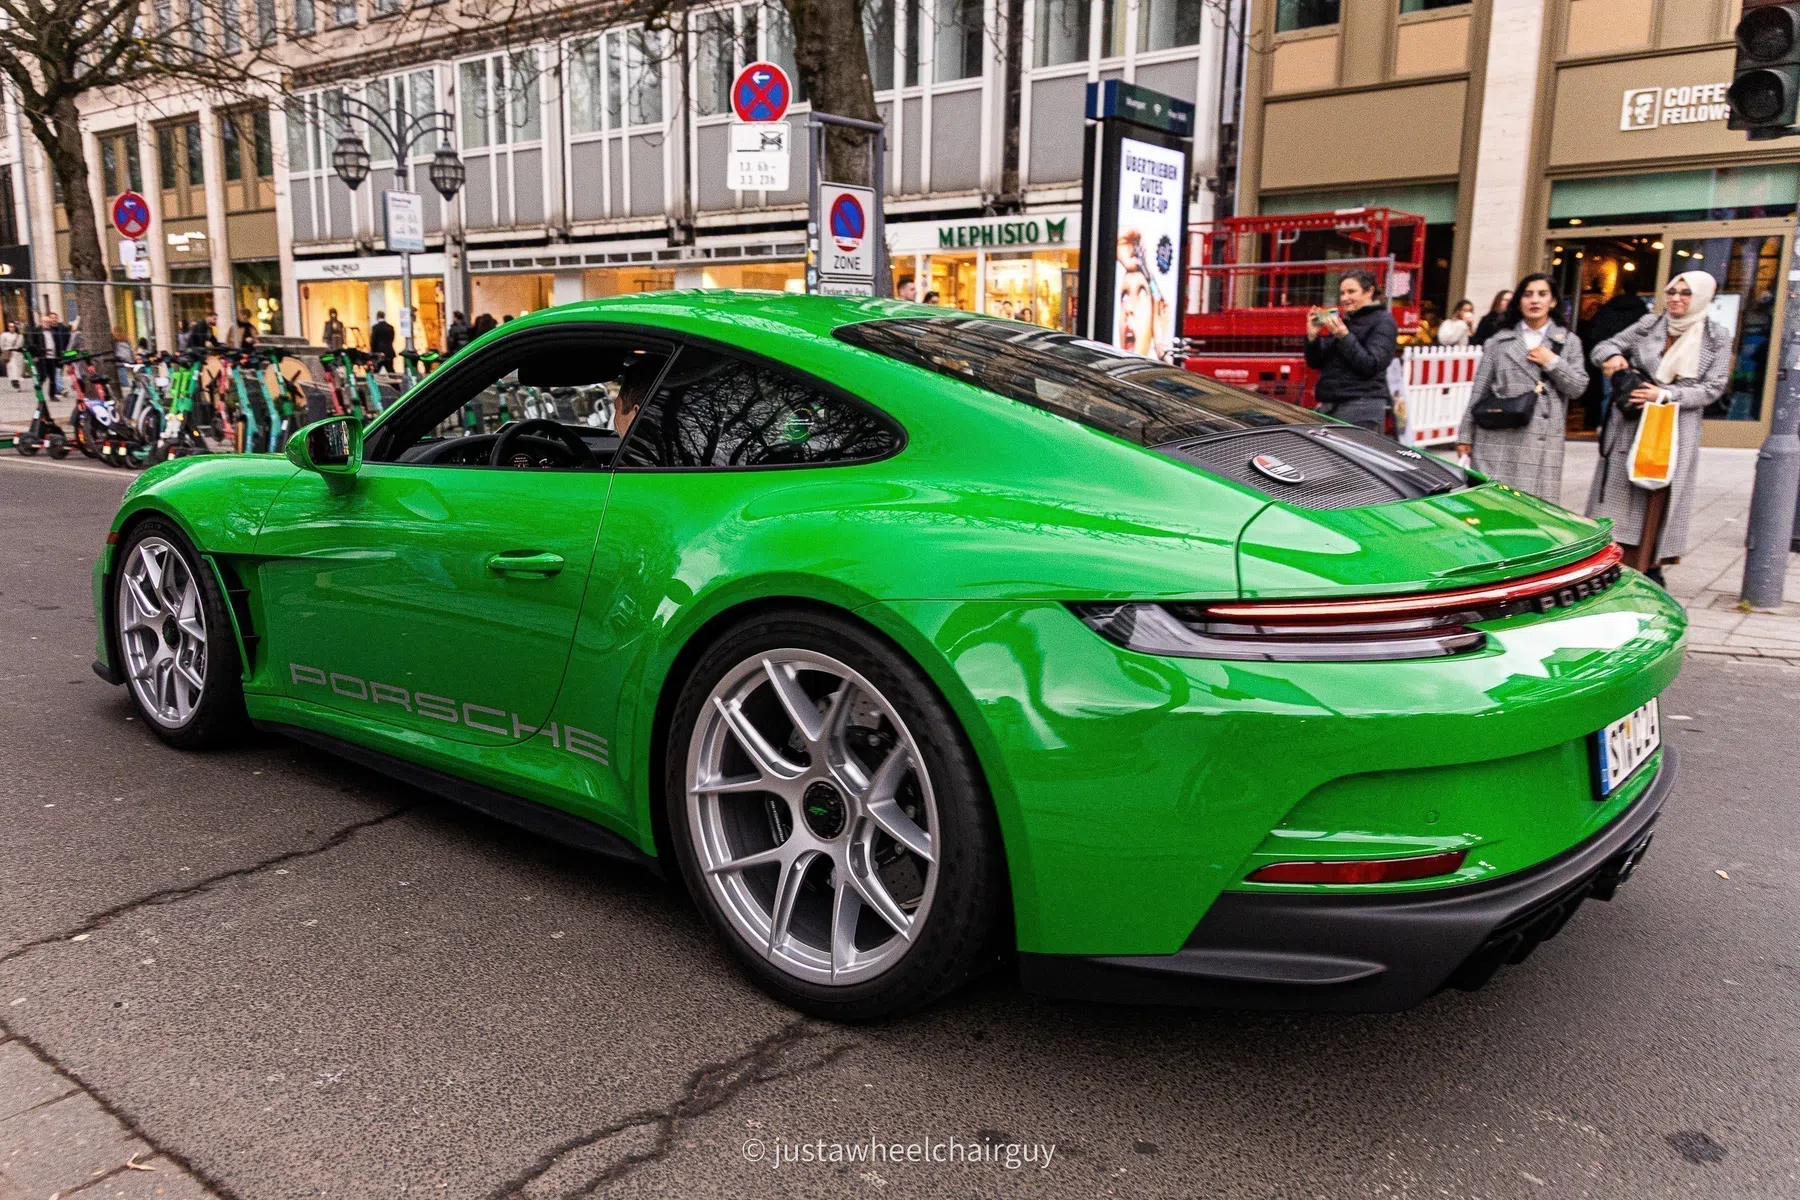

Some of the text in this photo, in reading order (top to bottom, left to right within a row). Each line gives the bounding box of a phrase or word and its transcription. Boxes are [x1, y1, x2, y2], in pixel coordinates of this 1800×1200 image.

[1663, 82, 1732, 107] COFFE
[1125, 149, 1177, 181] ÜBERTRIEBEN
[1140, 177, 1163, 196] GUTES
[1132, 194, 1169, 214] MAKE-UP
[938, 221, 1039, 248] MEPHISTO
[834, 255, 861, 270] ZONE
[289, 662, 610, 767] PORSCHE
